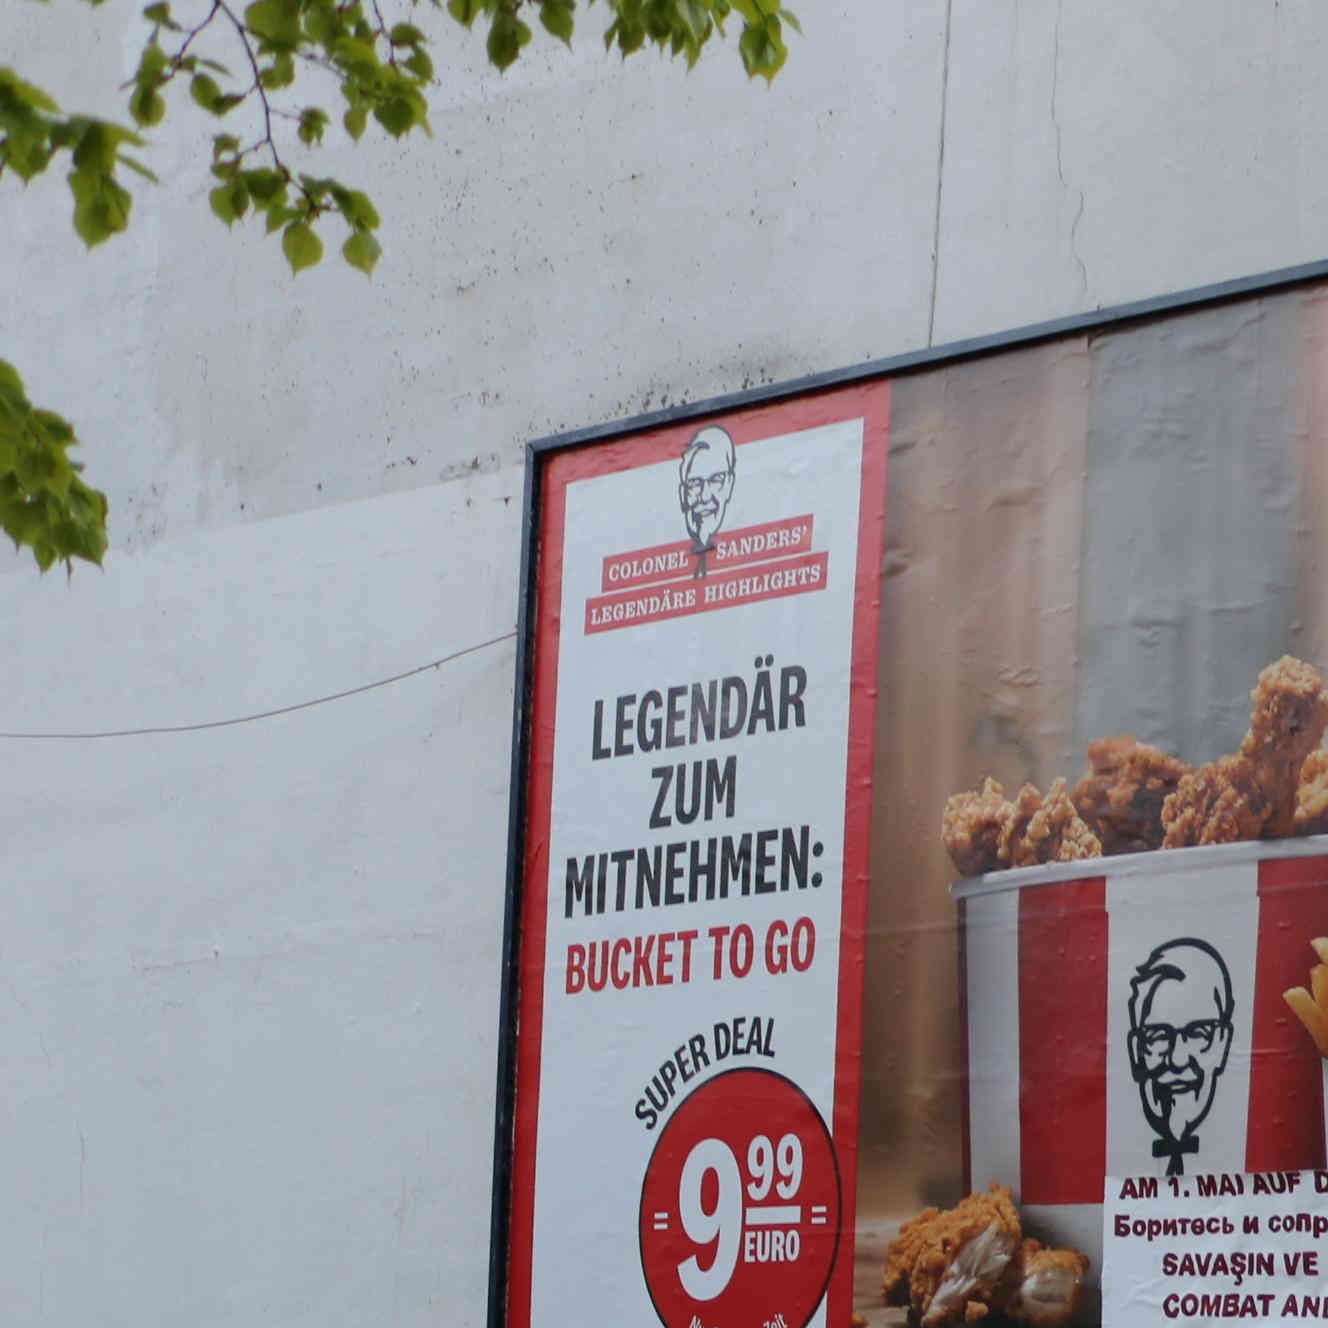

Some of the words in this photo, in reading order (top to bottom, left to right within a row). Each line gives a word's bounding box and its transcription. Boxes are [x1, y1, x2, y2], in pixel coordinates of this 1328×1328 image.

[608, 552, 689, 582] COLONEL
[590, 587, 696, 625] LEGENDÄRE
[704, 564, 821, 603] HIGHLIGHTS
[592, 654, 807, 760] LEGENDÄR
[649, 756, 737, 829] ZUM
[564, 825, 824, 919] MITNEHMEN:
[566, 929, 698, 994] BUCKET
[708, 922, 754, 979] TO
[765, 917, 816, 975] GO
[635, 1034, 710, 1130] SUPER
[714, 1016, 776, 1059] DEAL
[1119, 1177, 1158, 1200] AM
[1168, 1177, 1190, 1198] 1.
[1197, 1174, 1244, 1197] MAI
[1252, 1171, 1301, 1195] AUF
[744, 1229, 801, 1263] EURO
[1114, 1214, 1234, 1241] Боритесь
[1243, 1216, 1260, 1234] и
[1162, 1252, 1275, 1285] SAVAŞIN
[1284, 1251, 1319, 1276] VE
[1163, 1294, 1275, 1318] COMBAT
